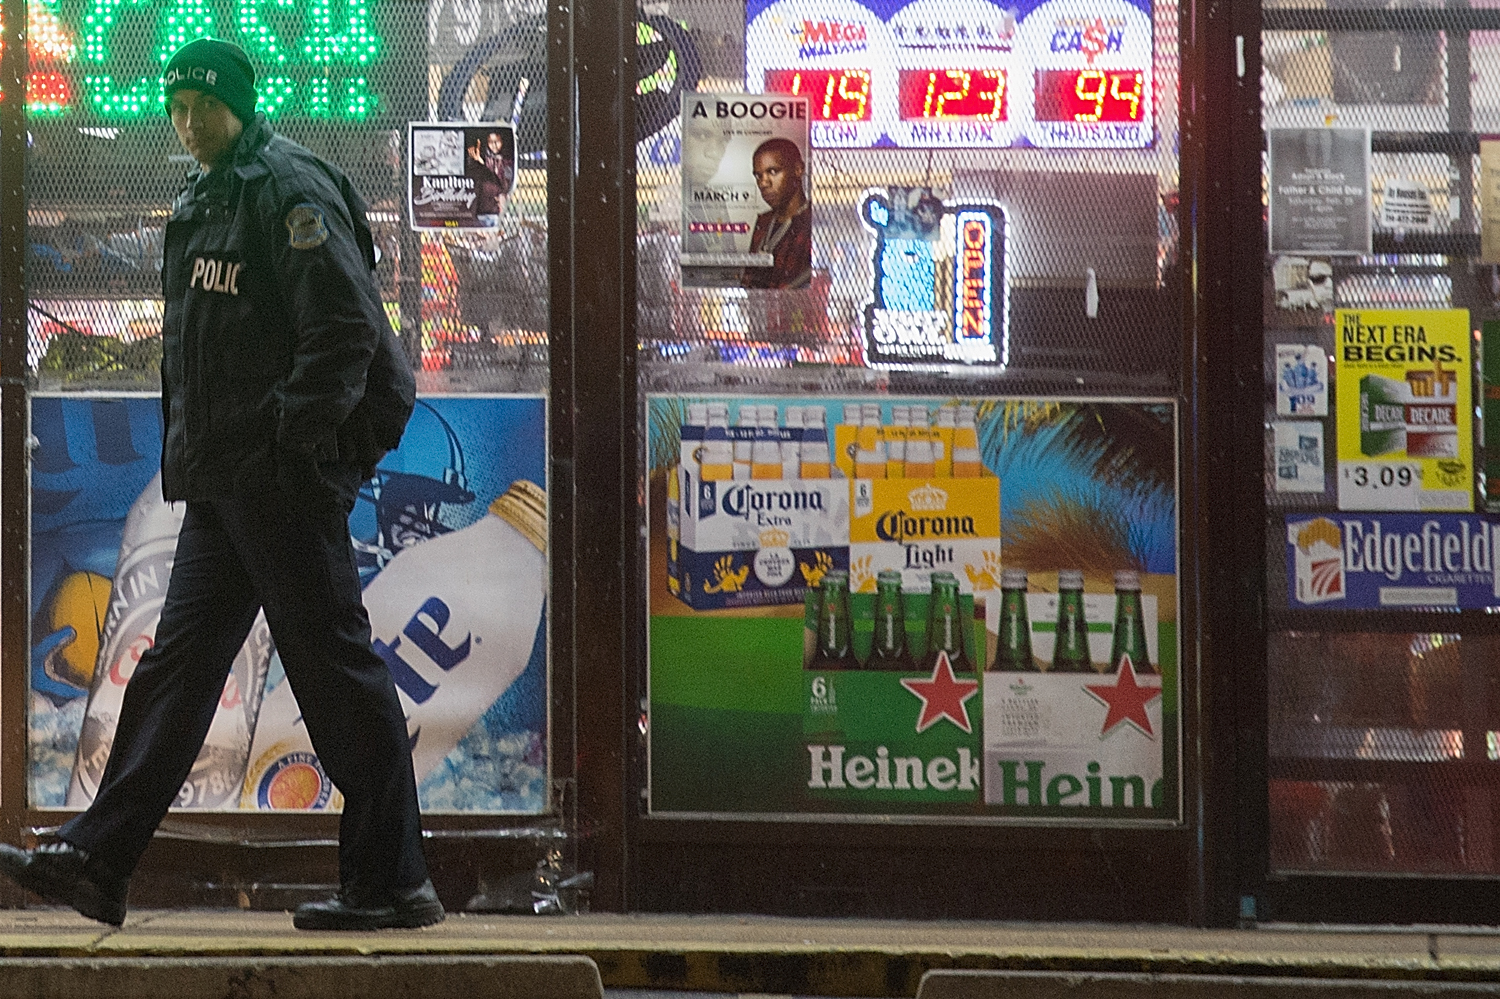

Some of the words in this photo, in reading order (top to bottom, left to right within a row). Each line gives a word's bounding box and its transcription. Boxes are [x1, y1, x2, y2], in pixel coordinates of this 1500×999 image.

[692, 100, 708, 119] A
[716, 101, 807, 120] BOOGIE
[923, 70, 1006, 122] 123
[1074, 70, 1142, 122] 94
[694, 191, 739, 202] MARCH
[190, 256, 241, 296] POLIC
[962, 220, 986, 338] OPEN
[1343, 325, 1388, 344] NEXT
[1393, 325, 1428, 344] ERA
[1343, 344, 1463, 363] BEGINS.
[722, 485, 824, 522] Corona
[757, 511, 792, 527] Extra
[876, 511, 976, 546] Corona
[903, 543, 955, 572] Light
[1343, 520, 1491, 581] Edgefield
[811, 676, 828, 696] 6
[807, 746, 981, 792] Heinek
